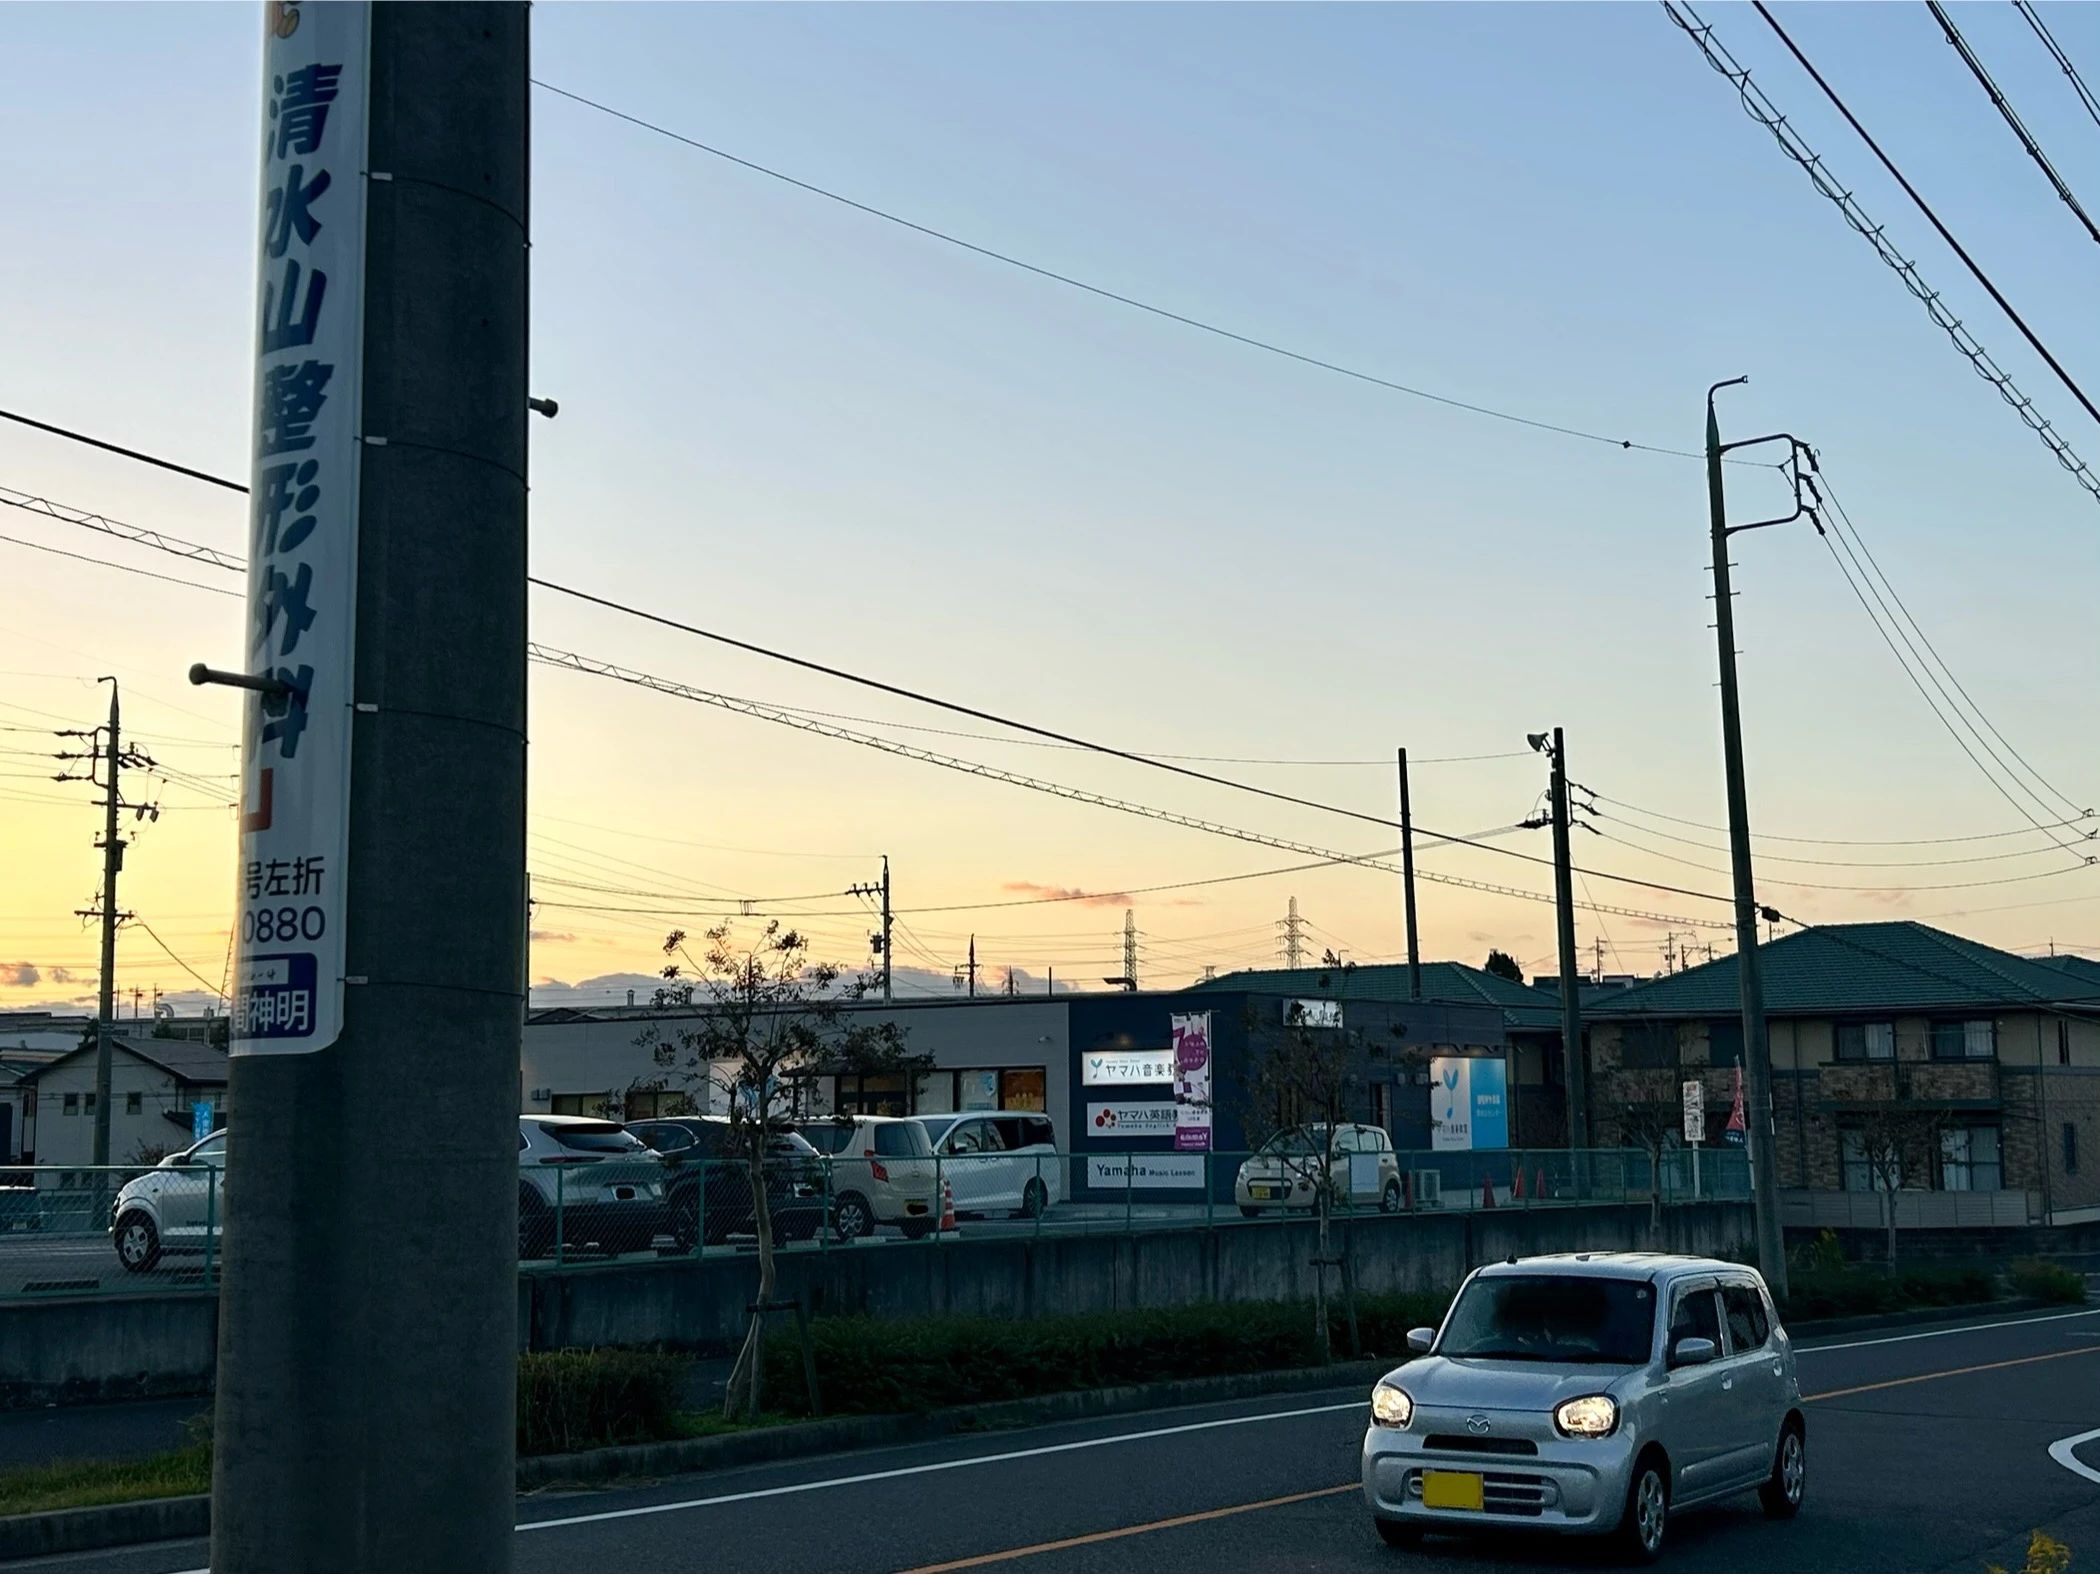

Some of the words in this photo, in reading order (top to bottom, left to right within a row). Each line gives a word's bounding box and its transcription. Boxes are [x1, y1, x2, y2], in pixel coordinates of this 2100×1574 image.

[245, 856, 325, 899] 号左折
[242, 906, 326, 945] 0880
[1097, 1164, 1146, 1176] Yamaha
